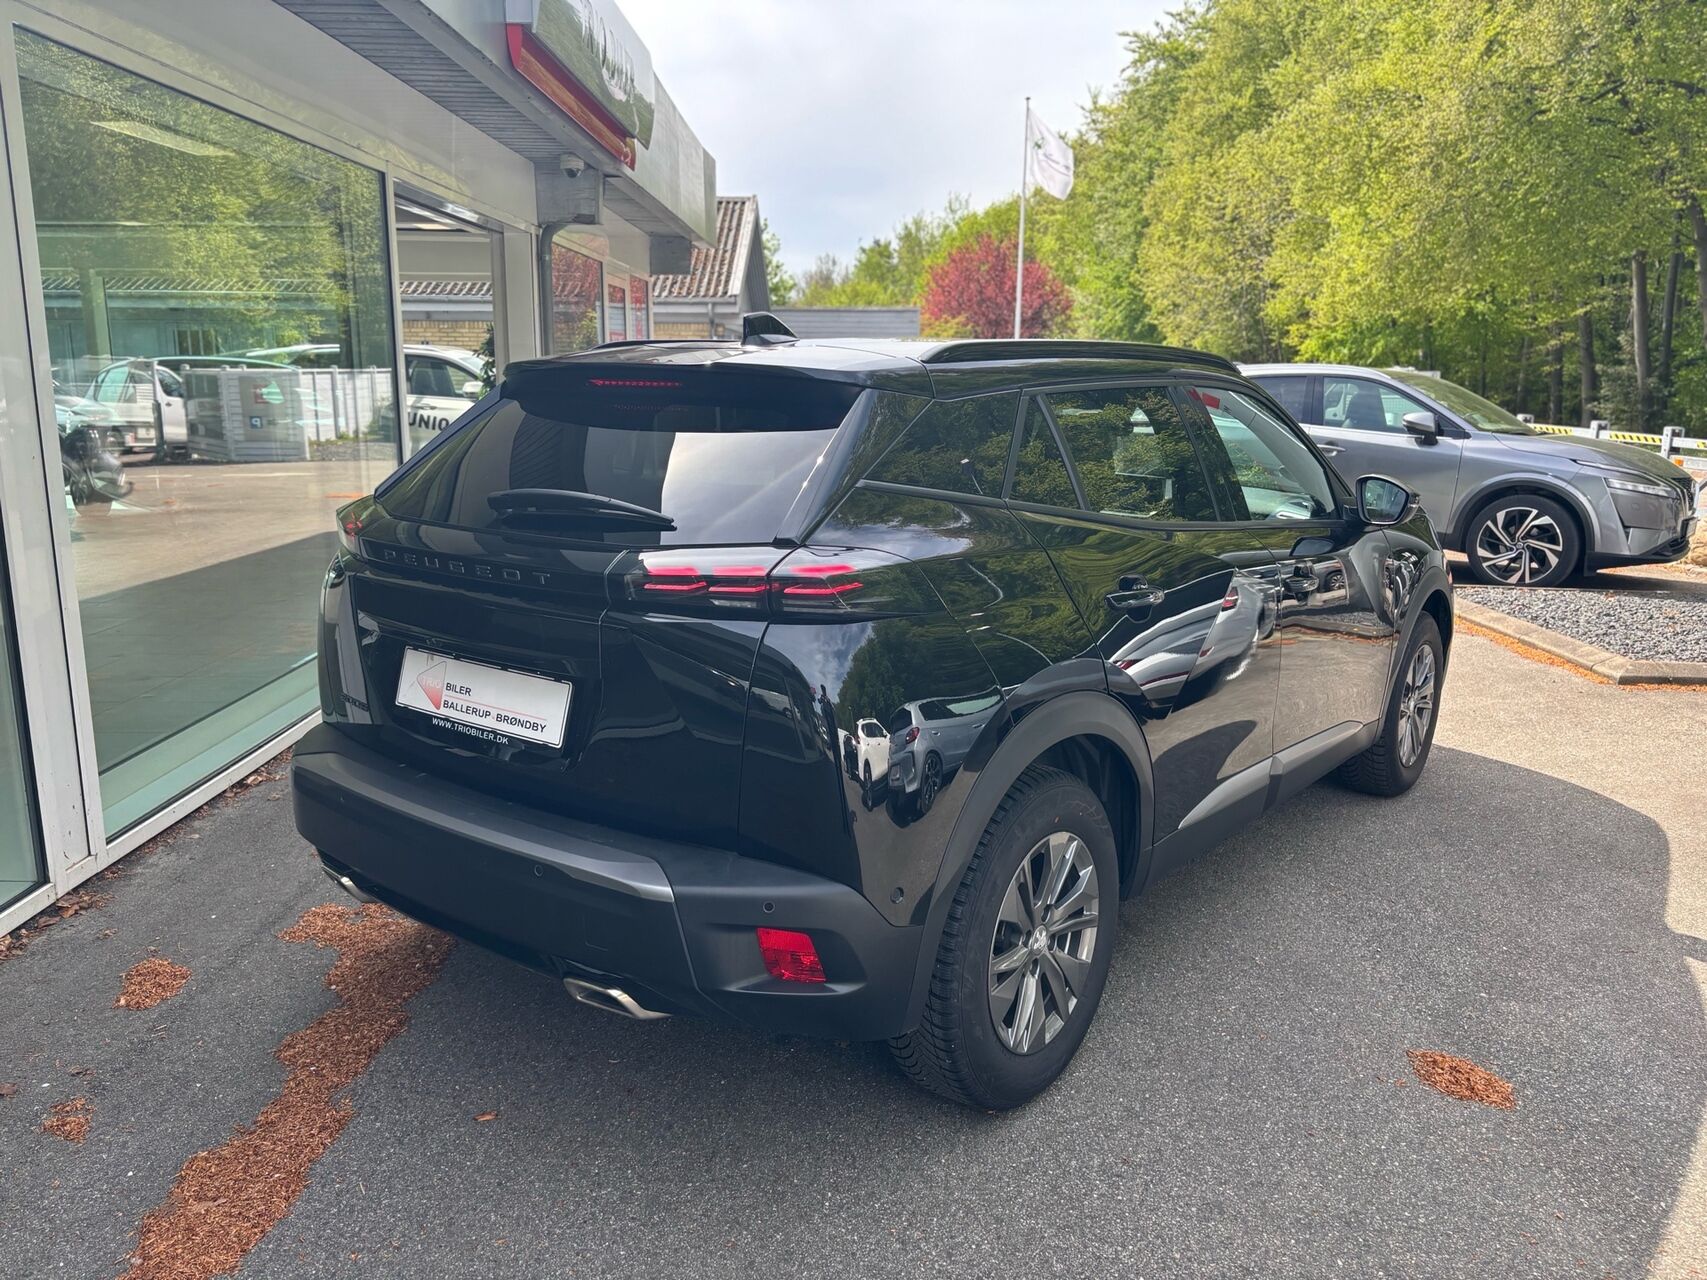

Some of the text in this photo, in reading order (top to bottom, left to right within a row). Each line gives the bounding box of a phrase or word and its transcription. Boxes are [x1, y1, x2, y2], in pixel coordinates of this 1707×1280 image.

[384, 549, 551, 585] PEUGEOT
[445, 682, 472, 697] BILER
[432, 717, 509, 745] WWW.TRIOBILER.DK
